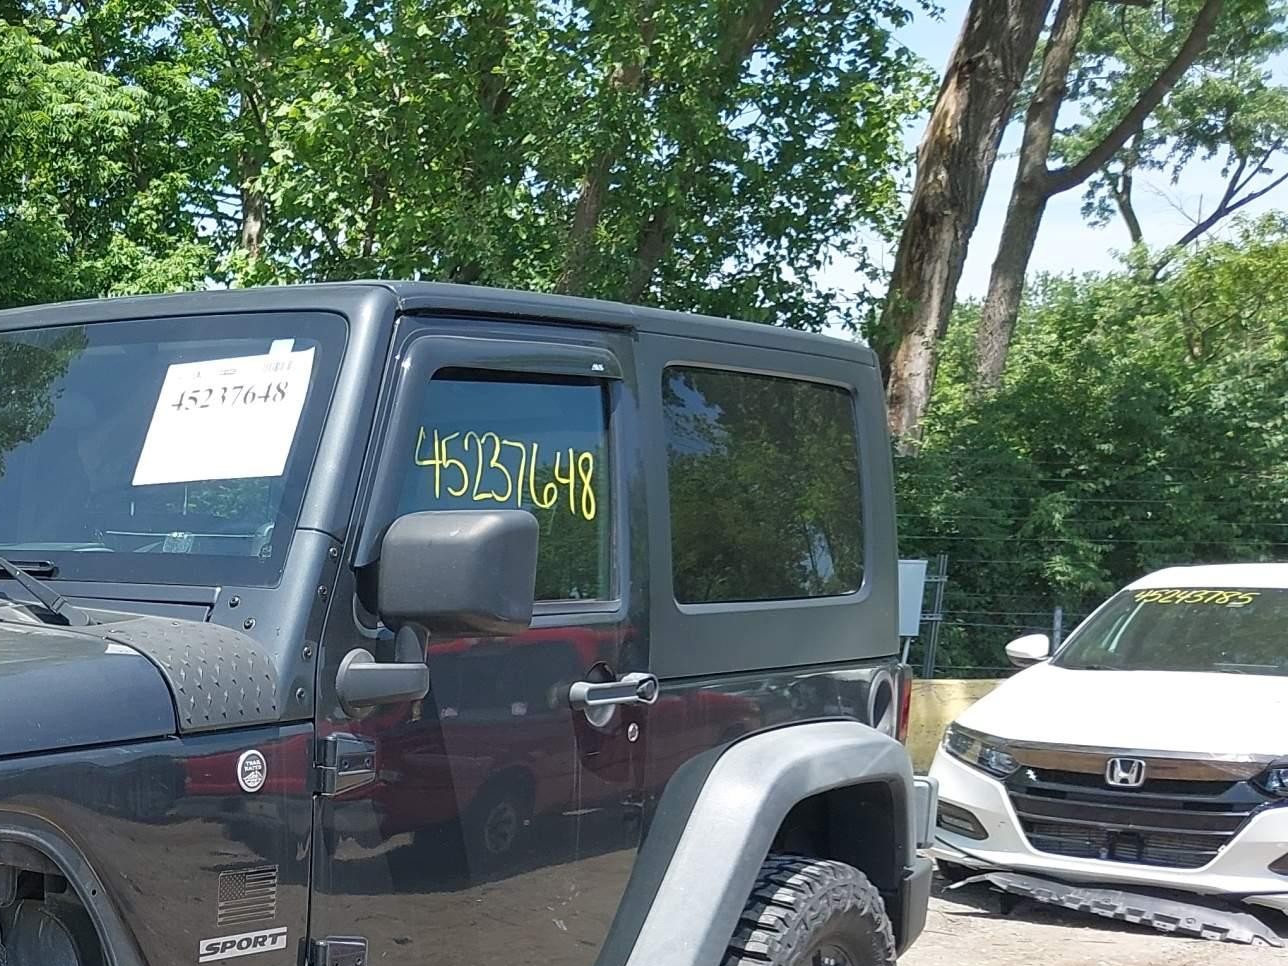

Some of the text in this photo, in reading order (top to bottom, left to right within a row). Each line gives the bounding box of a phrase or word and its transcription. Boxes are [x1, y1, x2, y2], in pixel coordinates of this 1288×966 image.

[171, 381, 289, 411] 45237648
[415, 426, 596, 520] 45237648
[1134, 589, 1261, 605] 45243785
[205, 932, 285, 957] SPORT
